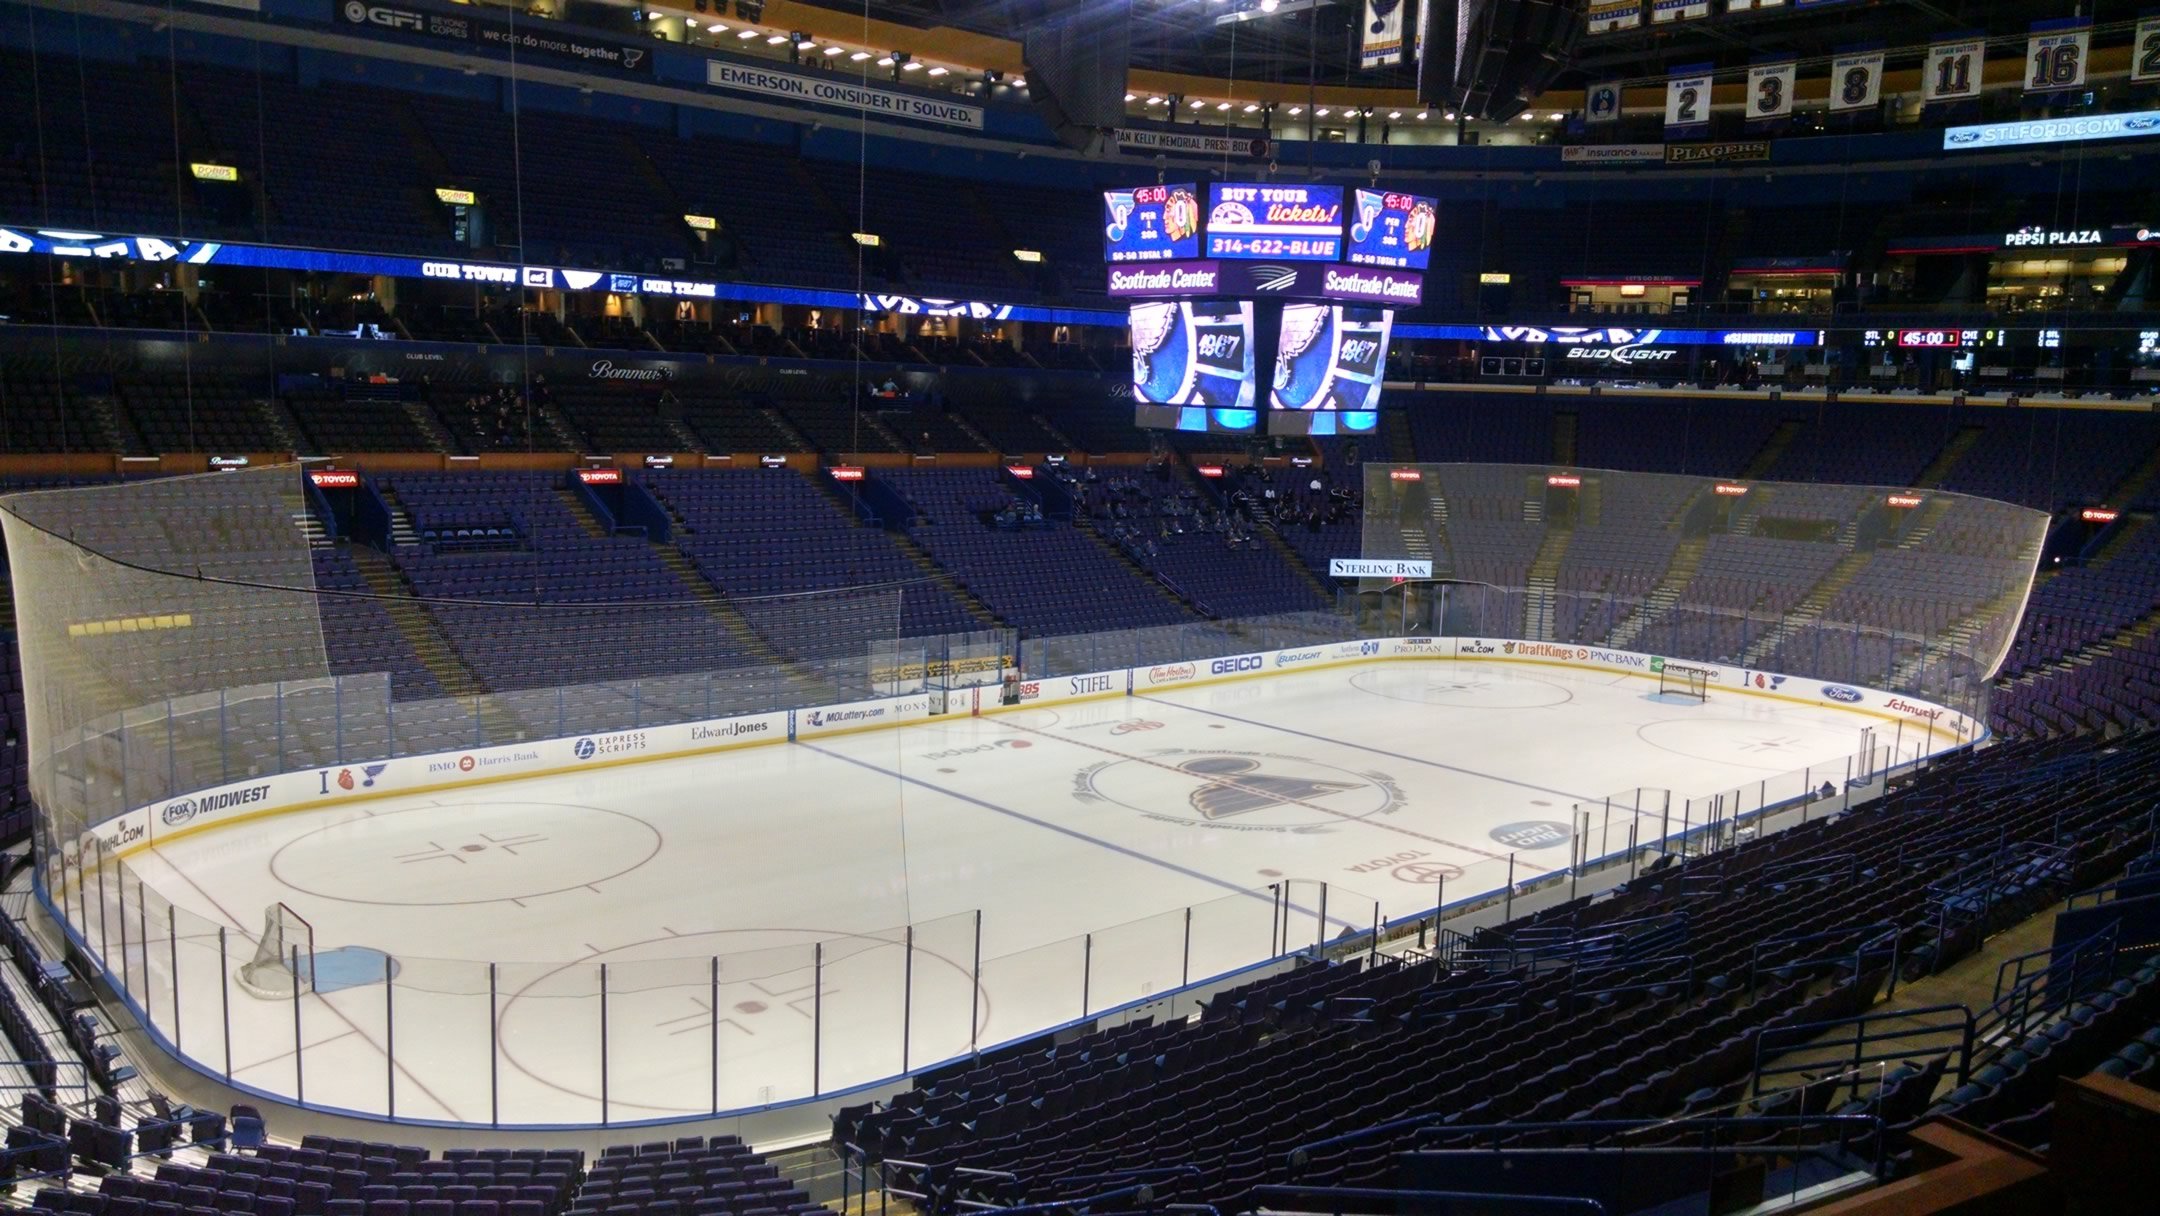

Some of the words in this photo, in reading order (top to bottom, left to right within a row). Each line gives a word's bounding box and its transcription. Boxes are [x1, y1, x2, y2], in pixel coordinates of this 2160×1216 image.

[431, 25, 467, 38] COPIES
[483, 29, 499, 41] we
[502, 32, 520, 44] can
[523, 34, 537, 47] do
[571, 43, 619, 61] together
[2032, 44, 2080, 87] 16
[1935, 54, 1971, 96] 11
[1842, 66, 1869, 104] 8
[721, 68, 808, 94] EMERSON.
[814, 83, 891, 109] CONSIDER
[896, 98, 909, 111] IT
[914, 102, 972, 122] SOLVED.
[1757, 76, 1783, 113] 3
[1677, 87, 1698, 121] 2
[1983, 118, 2120, 142] STLFORD.COM
[1134, 132, 1156, 145] KELLY
[1159, 136, 1201, 149] MEMORIAL
[1205, 139, 1229, 151] PRESS
[1232, 141, 1250, 153] BOX
[1672, 143, 1766, 162] PLAGERS
[1136, 188, 1167, 203] 45:00
[1221, 188, 1257, 202] BUY
[1260, 188, 1308, 203] YOUR
[1385, 194, 1413, 210] 45:00
[1116, 204, 1128, 231] 0
[1174, 200, 1187, 227] 0
[1266, 204, 1338, 223] tickets!
[1363, 205, 1374, 233] 0
[1414, 212, 1427, 239] 0
[2005, 233, 2045, 246] PEPSI
[2049, 230, 2102, 245] PLAZA
[1212, 239, 1335, 256] 314-622-BLUE
[422, 262, 461, 279] OUR
[462, 265, 518, 283] TOWN
[1111, 270, 1171, 290] Scottrade
[1172, 268, 1216, 288] Center
[642, 279, 674, 293] OUR
[674, 281, 716, 297] TEAM
[1325, 270, 1382, 294] Scottrade
[1383, 276, 1420, 299] Center
[1865, 330, 1880, 340] STL
[1888, 331, 1895, 339] 0
[1904, 332, 1944, 345] 45:00
[1962, 330, 1978, 340] CHI
[1986, 331, 1994, 339] 0
[425, 353, 444, 361] LEVEL
[1567, 347, 1611, 359] BUD
[1619, 349, 1677, 360] LIGHT
[324, 475, 356, 483] TOYOTA
[591, 473, 617, 481] TOYOTA
[1335, 560, 1394, 574] STERLING
[1397, 562, 1427, 575] BANK
[1278, 654, 1296, 664] BUD
[1296, 652, 1322, 662] LIGHT
[1461, 646, 1494, 654] NHL.COM
[1518, 642, 1573, 660] DraftKings
[1211, 655, 1263, 675] GEICO
[1590, 652, 1614, 664] PNC
[1615, 654, 1645, 668] BANK
[1153, 665, 1166, 678] Tim
[1166, 663, 1194, 678] Hortons
[1743, 671, 1750, 687] I
[1070, 675, 1114, 696] STIFEL
[1828, 688, 1855, 702] Ford
[826, 707, 885, 722] MOLottery.com
[599, 732, 646, 746] EXPRESS
[599, 741, 646, 754] SCRIPTS
[919, 743, 994, 761] pepsi
[428, 761, 456, 773] BMO
[479, 755, 510, 767] Harris
[514, 751, 539, 764] Bank
[319, 770, 329, 794] I
[169, 802, 190, 818] FOX
[200, 785, 270, 814] MIDWEST
[1500, 823, 1556, 844] LIGHT
[1518, 831, 1563, 846] BUD
[1344, 849, 1432, 874] TOYOTA
